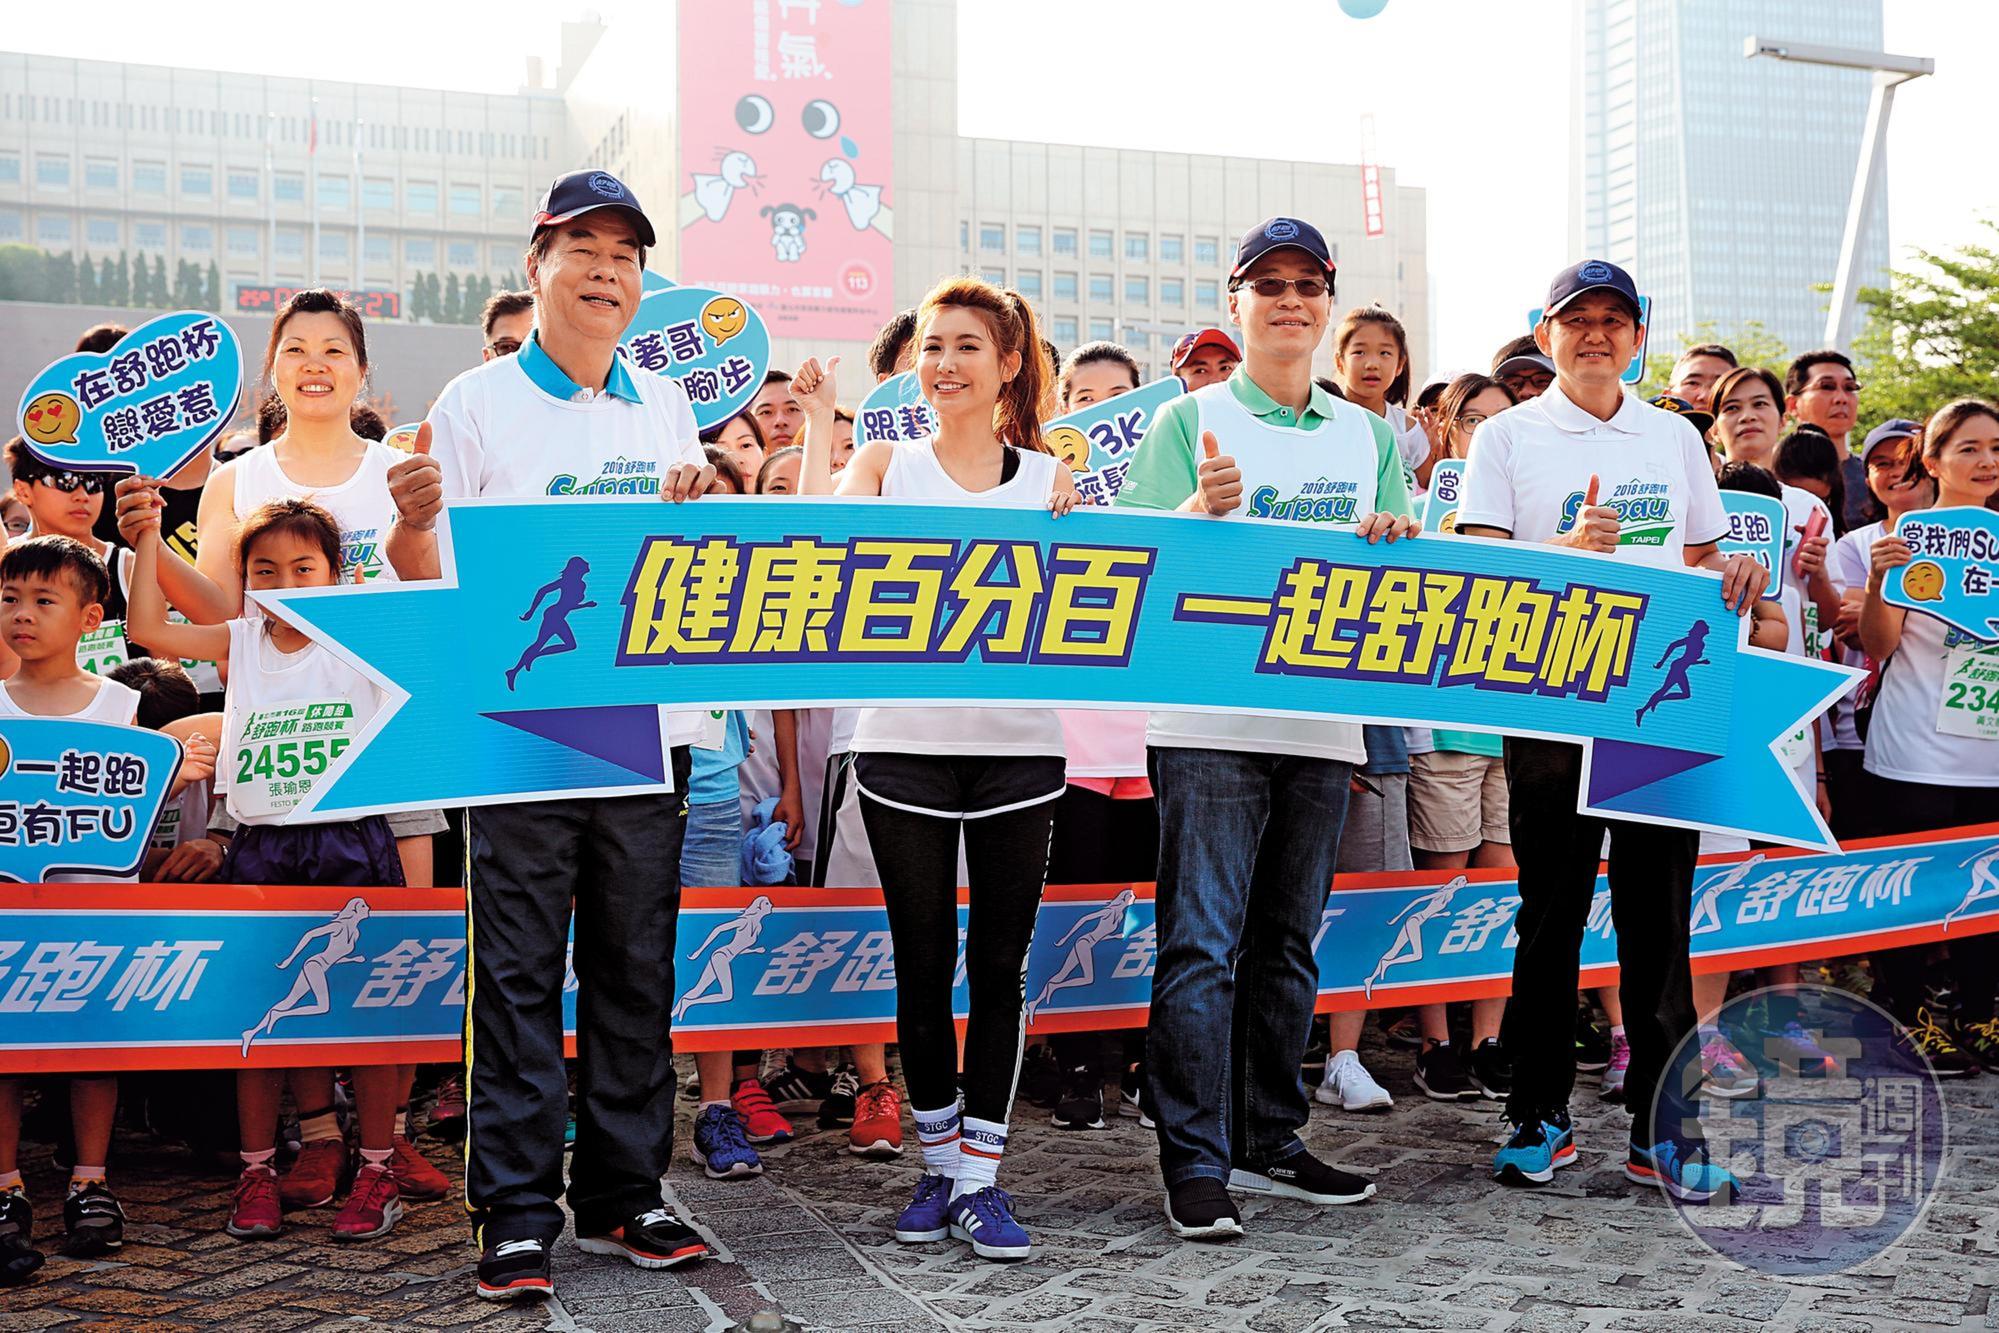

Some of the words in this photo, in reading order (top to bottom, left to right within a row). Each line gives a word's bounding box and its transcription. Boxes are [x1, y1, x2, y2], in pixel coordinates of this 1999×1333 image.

[74, 321, 218, 409] 在舒跑杯
[616, 322, 703, 371] 著哥
[673, 359, 752, 401] 腳步
[104, 384, 217, 451] 戀愛惹
[864, 406, 938, 441] 跟著
[1089, 411, 1143, 455] 3K
[1631, 536, 1660, 544] TAIPEI
[1964, 566, 1999, 594] 在
[620, 537, 1155, 662] 健康百分百
[1178, 559, 1647, 697] 一起舒跑杯
[251, 718, 300, 740] 舒跑杯
[17, 752, 145, 795] 一起跑
[1736, 856, 1935, 924] 舒跑杯
[1438, 895, 1523, 955] 舒
[0, 940, 224, 1013] 跑杯
[352, 938, 466, 1009] 舒
[924, 1120, 948, 1132] STGC
[975, 1131, 999, 1144] STGC
